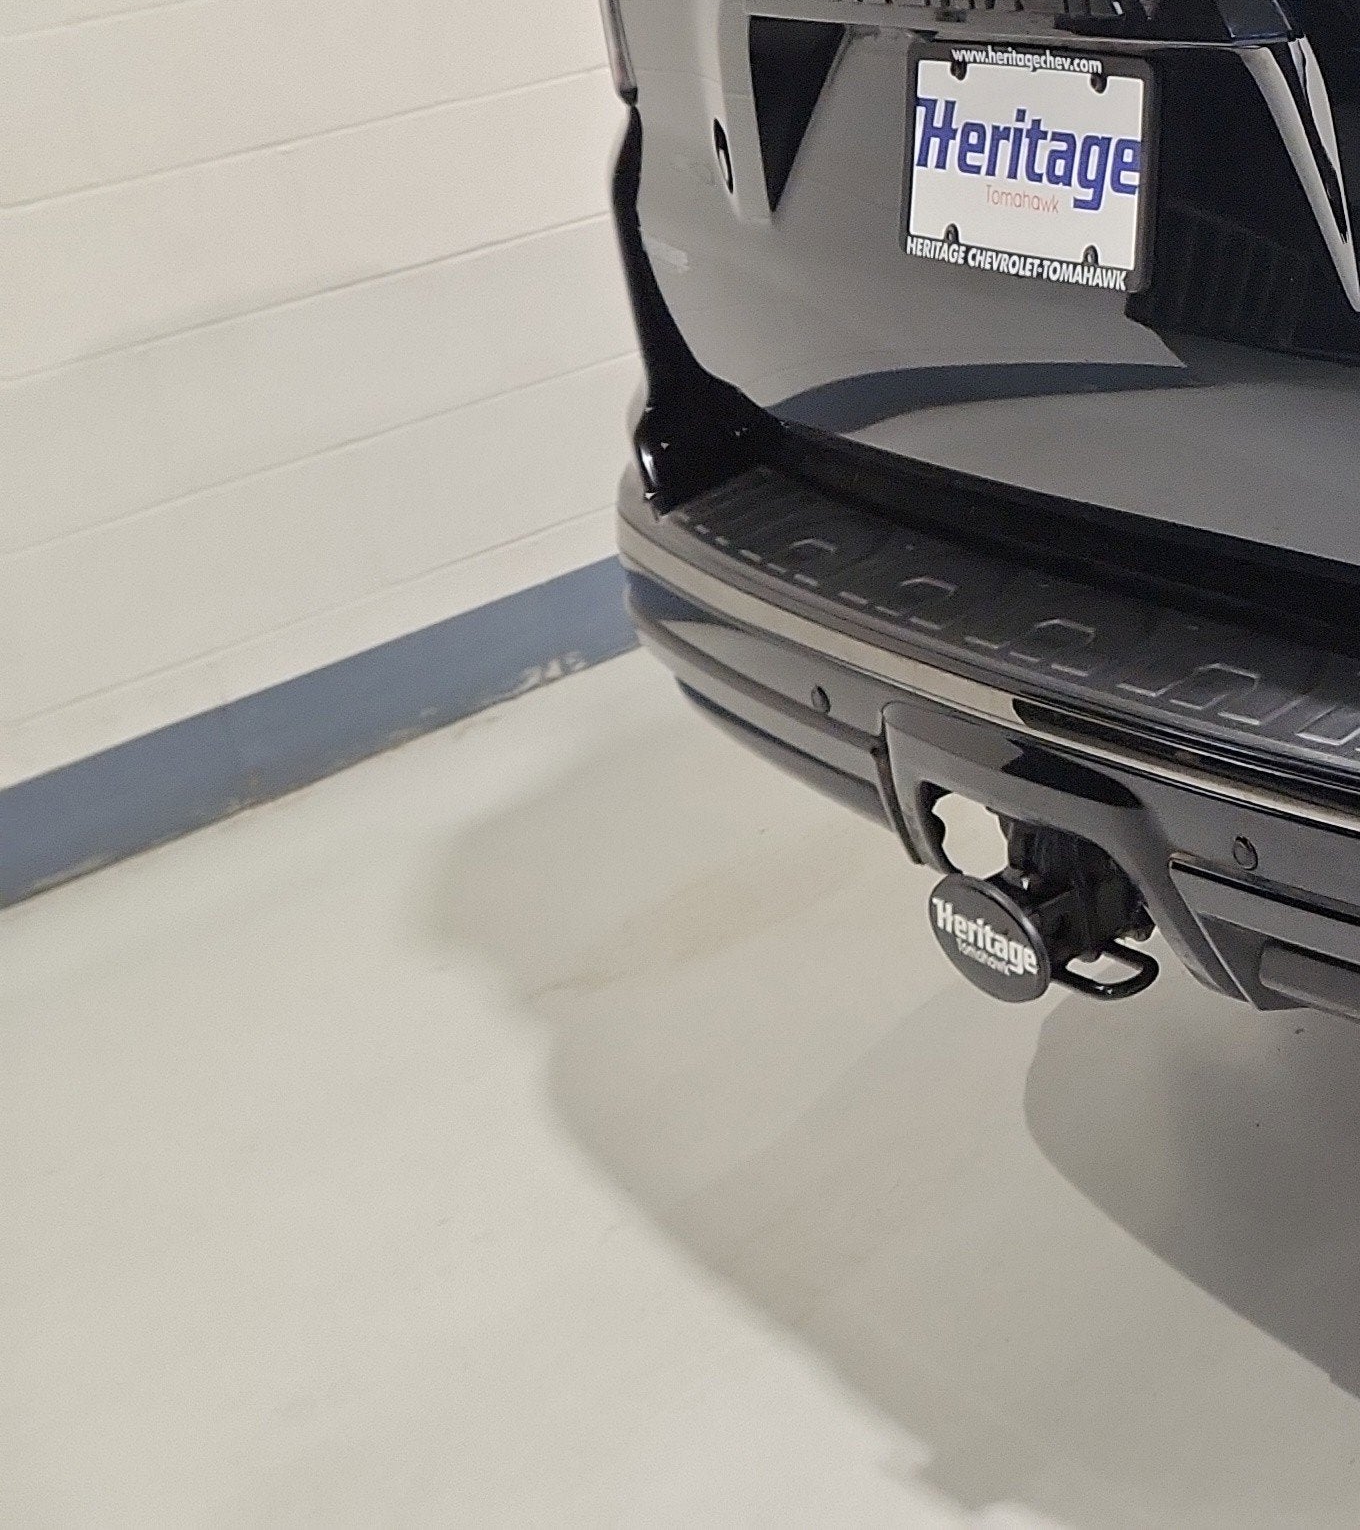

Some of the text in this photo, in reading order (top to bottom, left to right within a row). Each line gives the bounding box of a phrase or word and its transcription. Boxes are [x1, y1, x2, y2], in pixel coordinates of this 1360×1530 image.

[951, 45, 1103, 74] www.heritagechev.com
[915, 96, 1142, 211] Heritage
[985, 183, 1060, 214] Tomahawk
[906, 235, 1128, 292] HERITAGE CHEVROLET-TOMAHAWK
[931, 896, 1039, 976] Heritage
